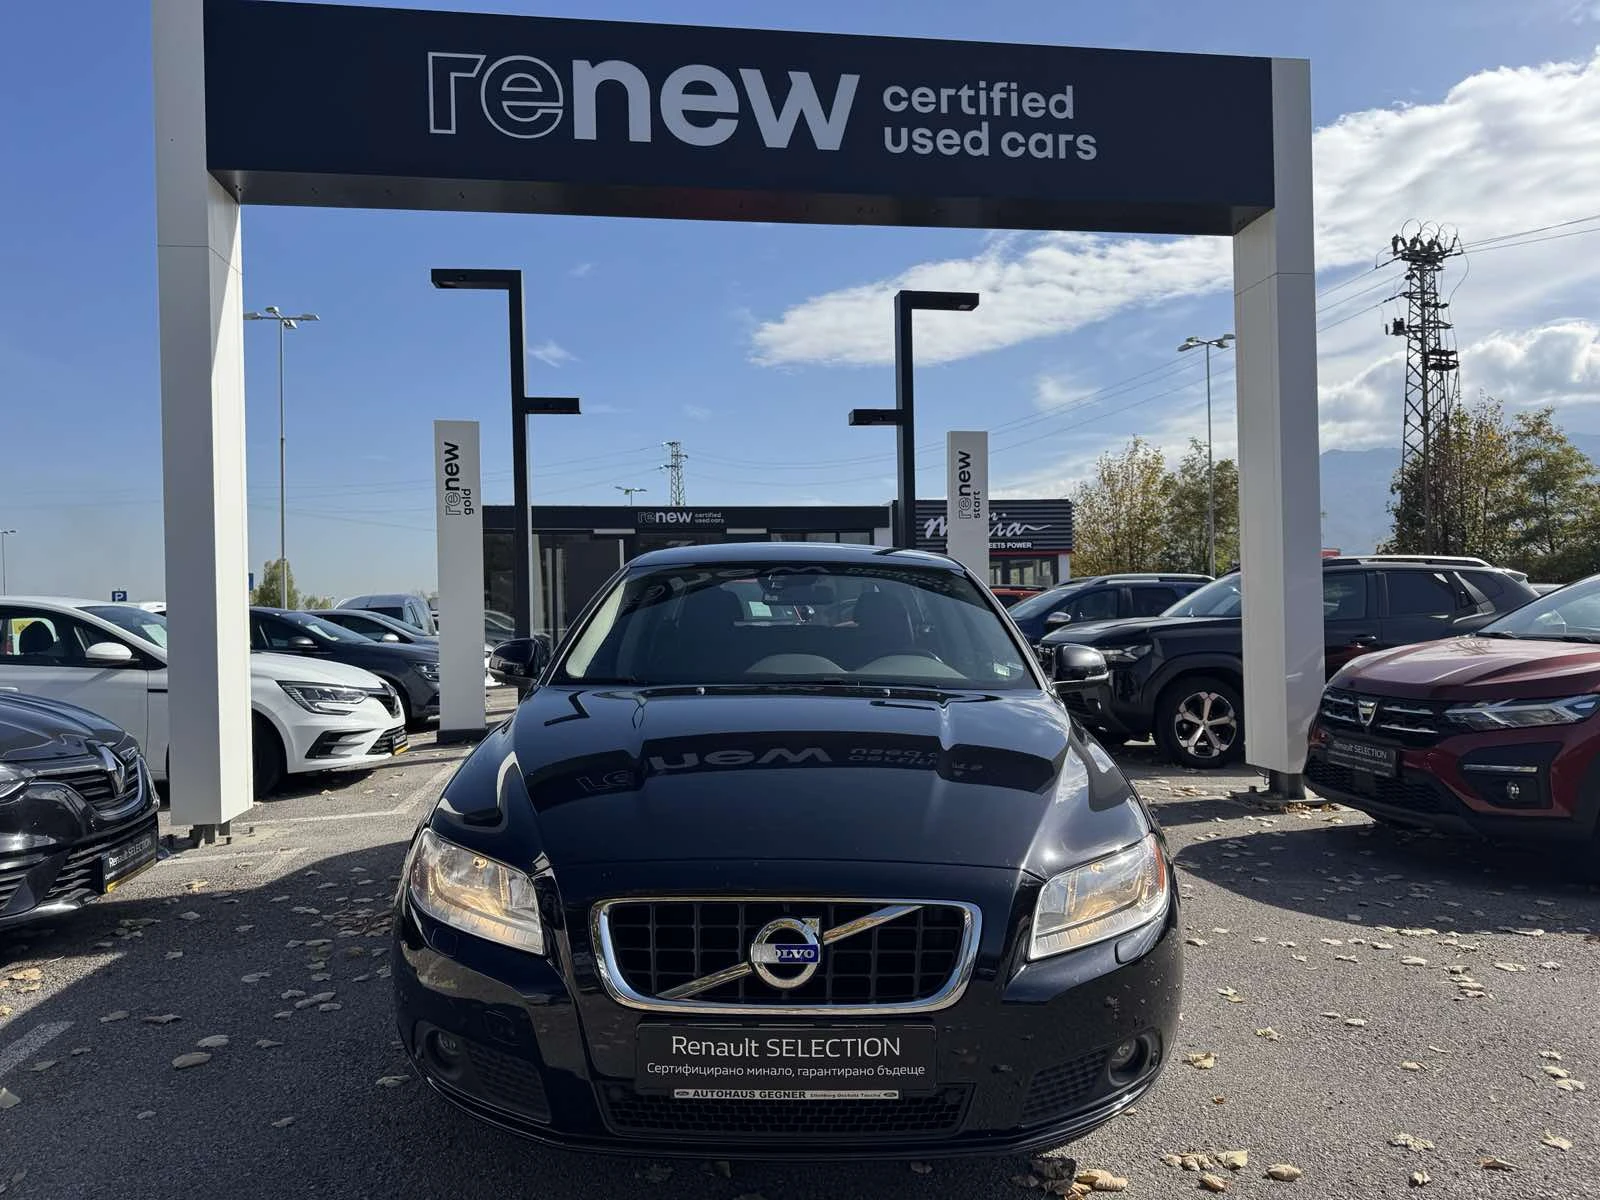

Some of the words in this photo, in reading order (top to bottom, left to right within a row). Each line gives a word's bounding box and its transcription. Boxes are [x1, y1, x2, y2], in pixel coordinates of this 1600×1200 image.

[427, 51, 860, 151] renew
[883, 80, 1074, 119] certified
[884, 121, 990, 157] used
[1000, 131, 1098, 160] cars
[444, 441, 461, 516] renew
[958, 450, 971, 519] renew
[461, 488, 475, 516] gold
[973, 490, 981, 519] start
[638, 511, 693, 524] renew
[671, 1036, 760, 1057] Renault
[766, 1037, 900, 1058] SELECTION
[647, 1062, 744, 1077] Сертифицирано
[746, 1067, 795, 1077] минало,
[798, 1067, 875, 1078] гарантирано
[877, 1065, 925, 1076] бъдеще
[692, 1090, 756, 1099] AUTOHAUS
[759, 1091, 806, 1099] GEGNER
